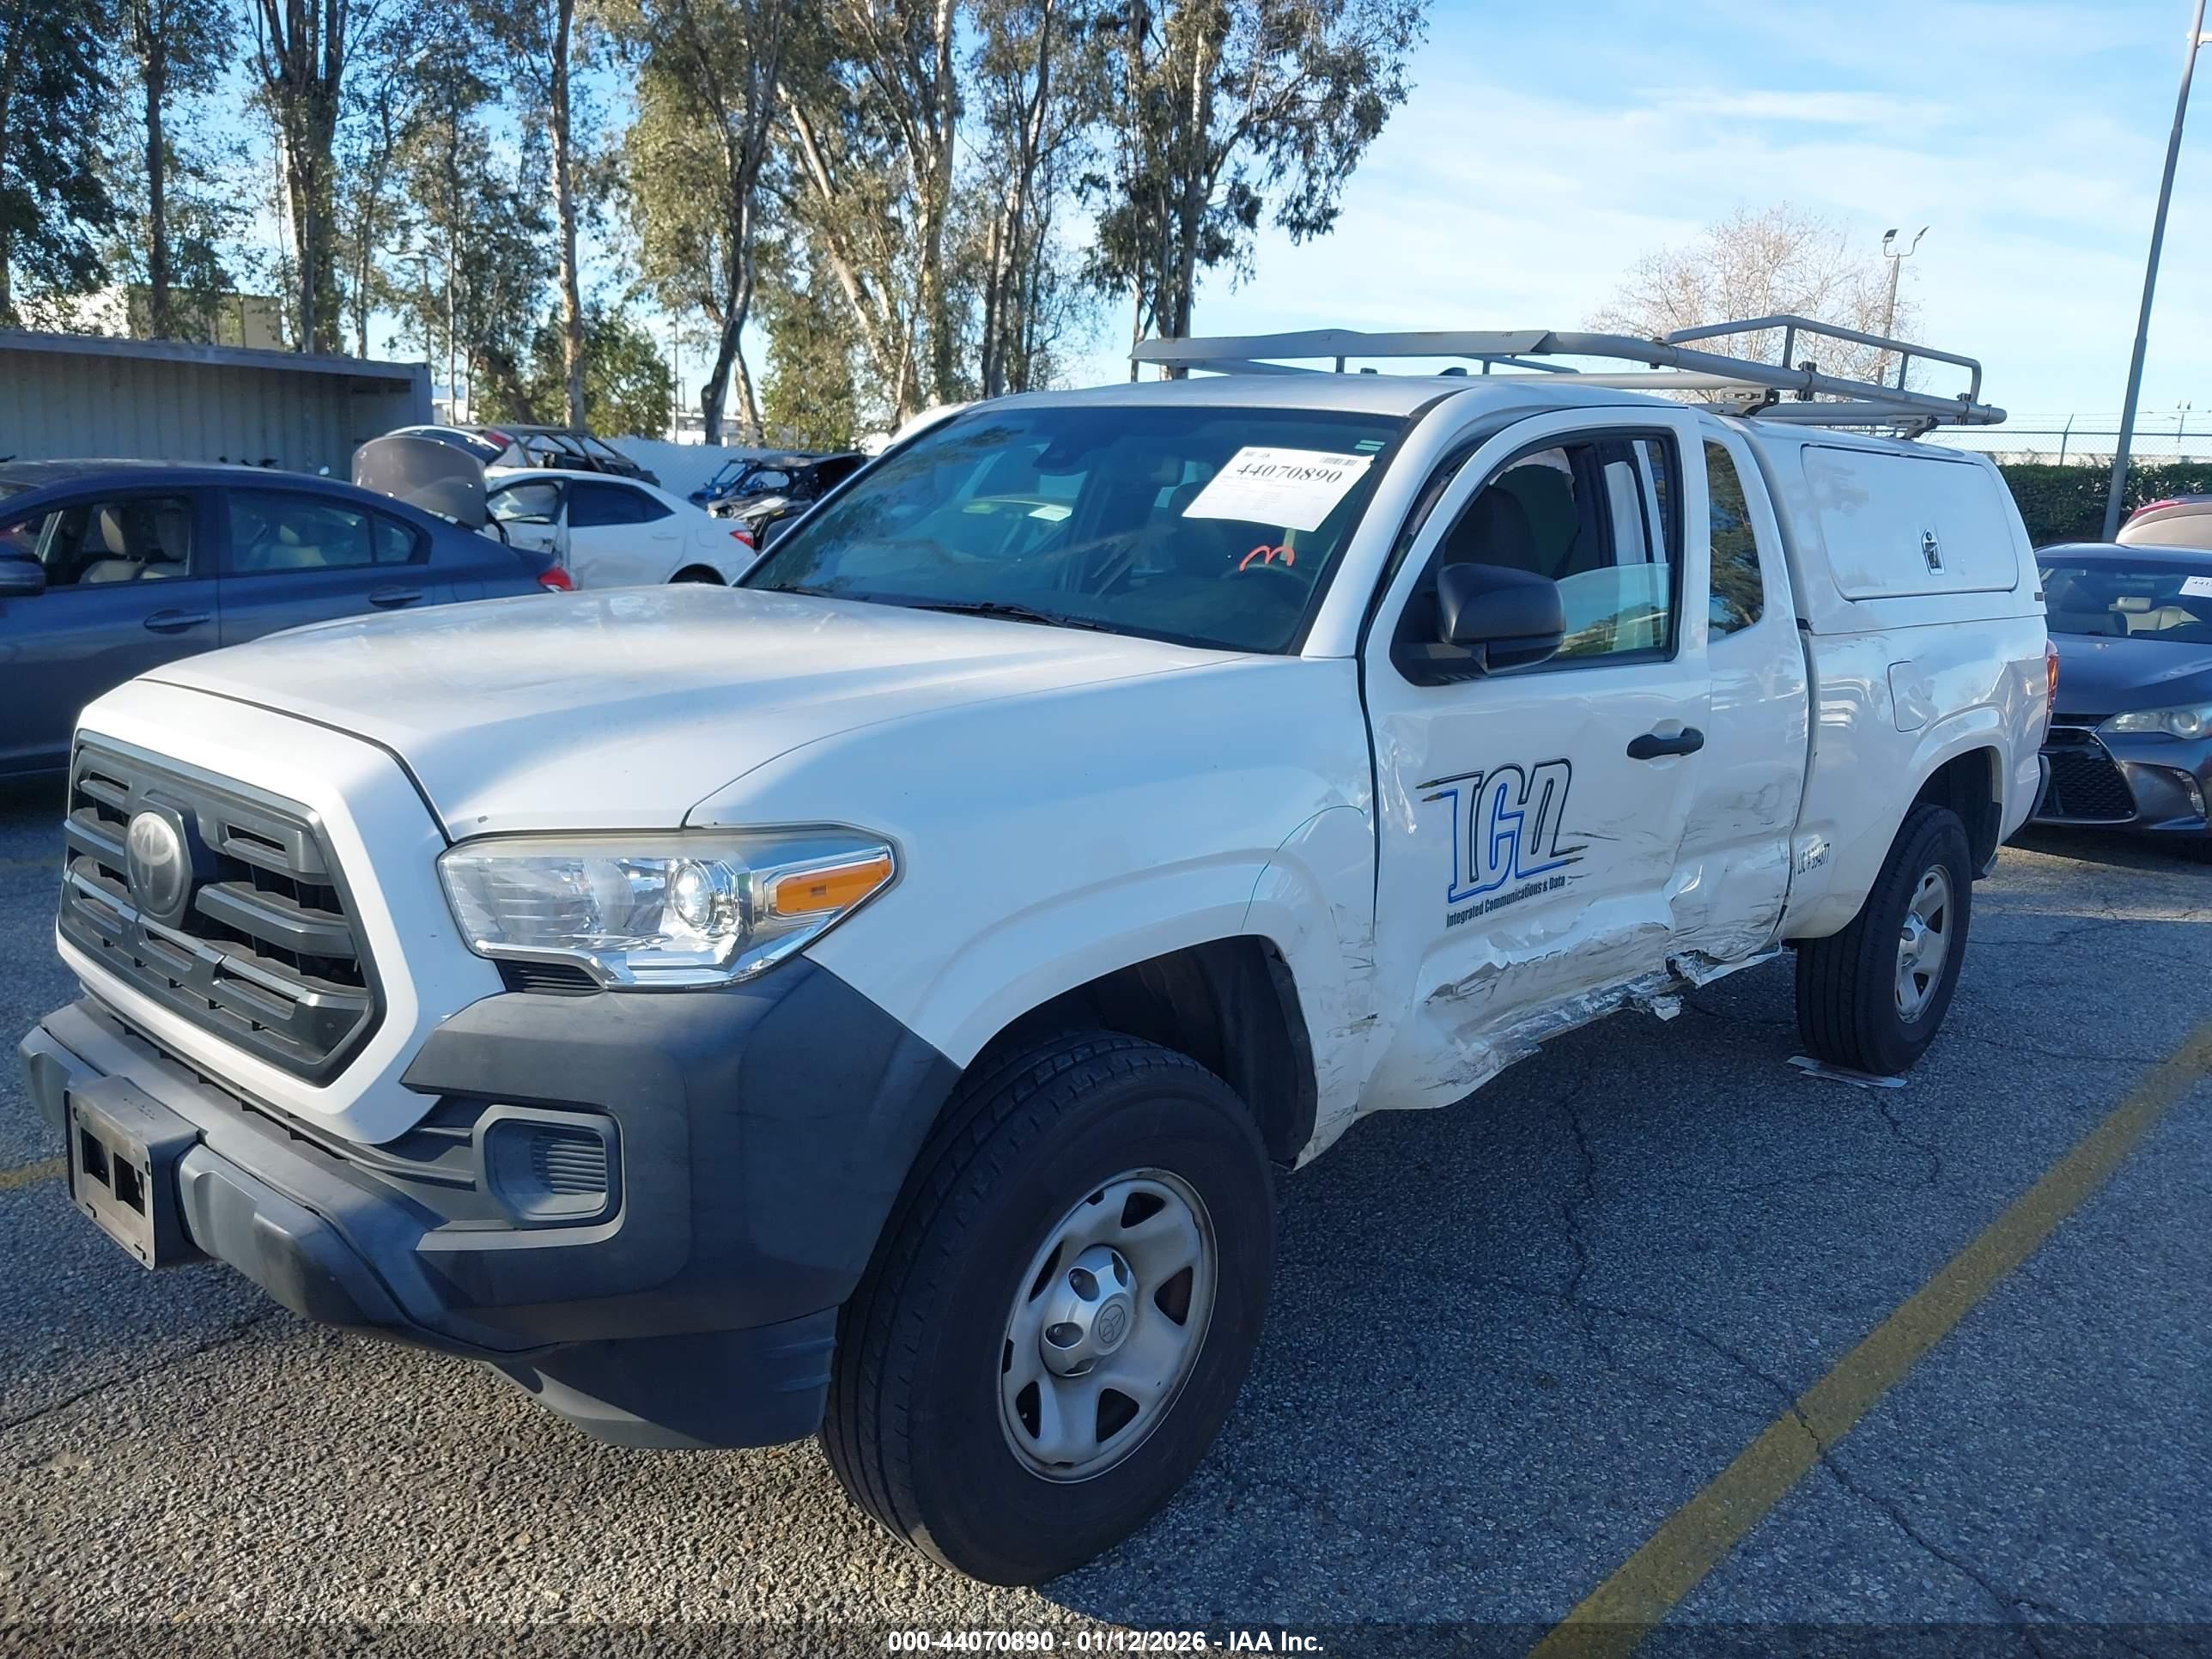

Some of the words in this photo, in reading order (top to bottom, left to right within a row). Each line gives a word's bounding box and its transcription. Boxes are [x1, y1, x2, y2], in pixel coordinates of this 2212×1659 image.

[1237, 463, 1343, 483] 44070890
[1446, 900, 1484, 927] Integrated
[1485, 882, 1542, 913] Communications
[1542, 880, 1548, 893] &
[1549, 875, 1565, 890] Data
